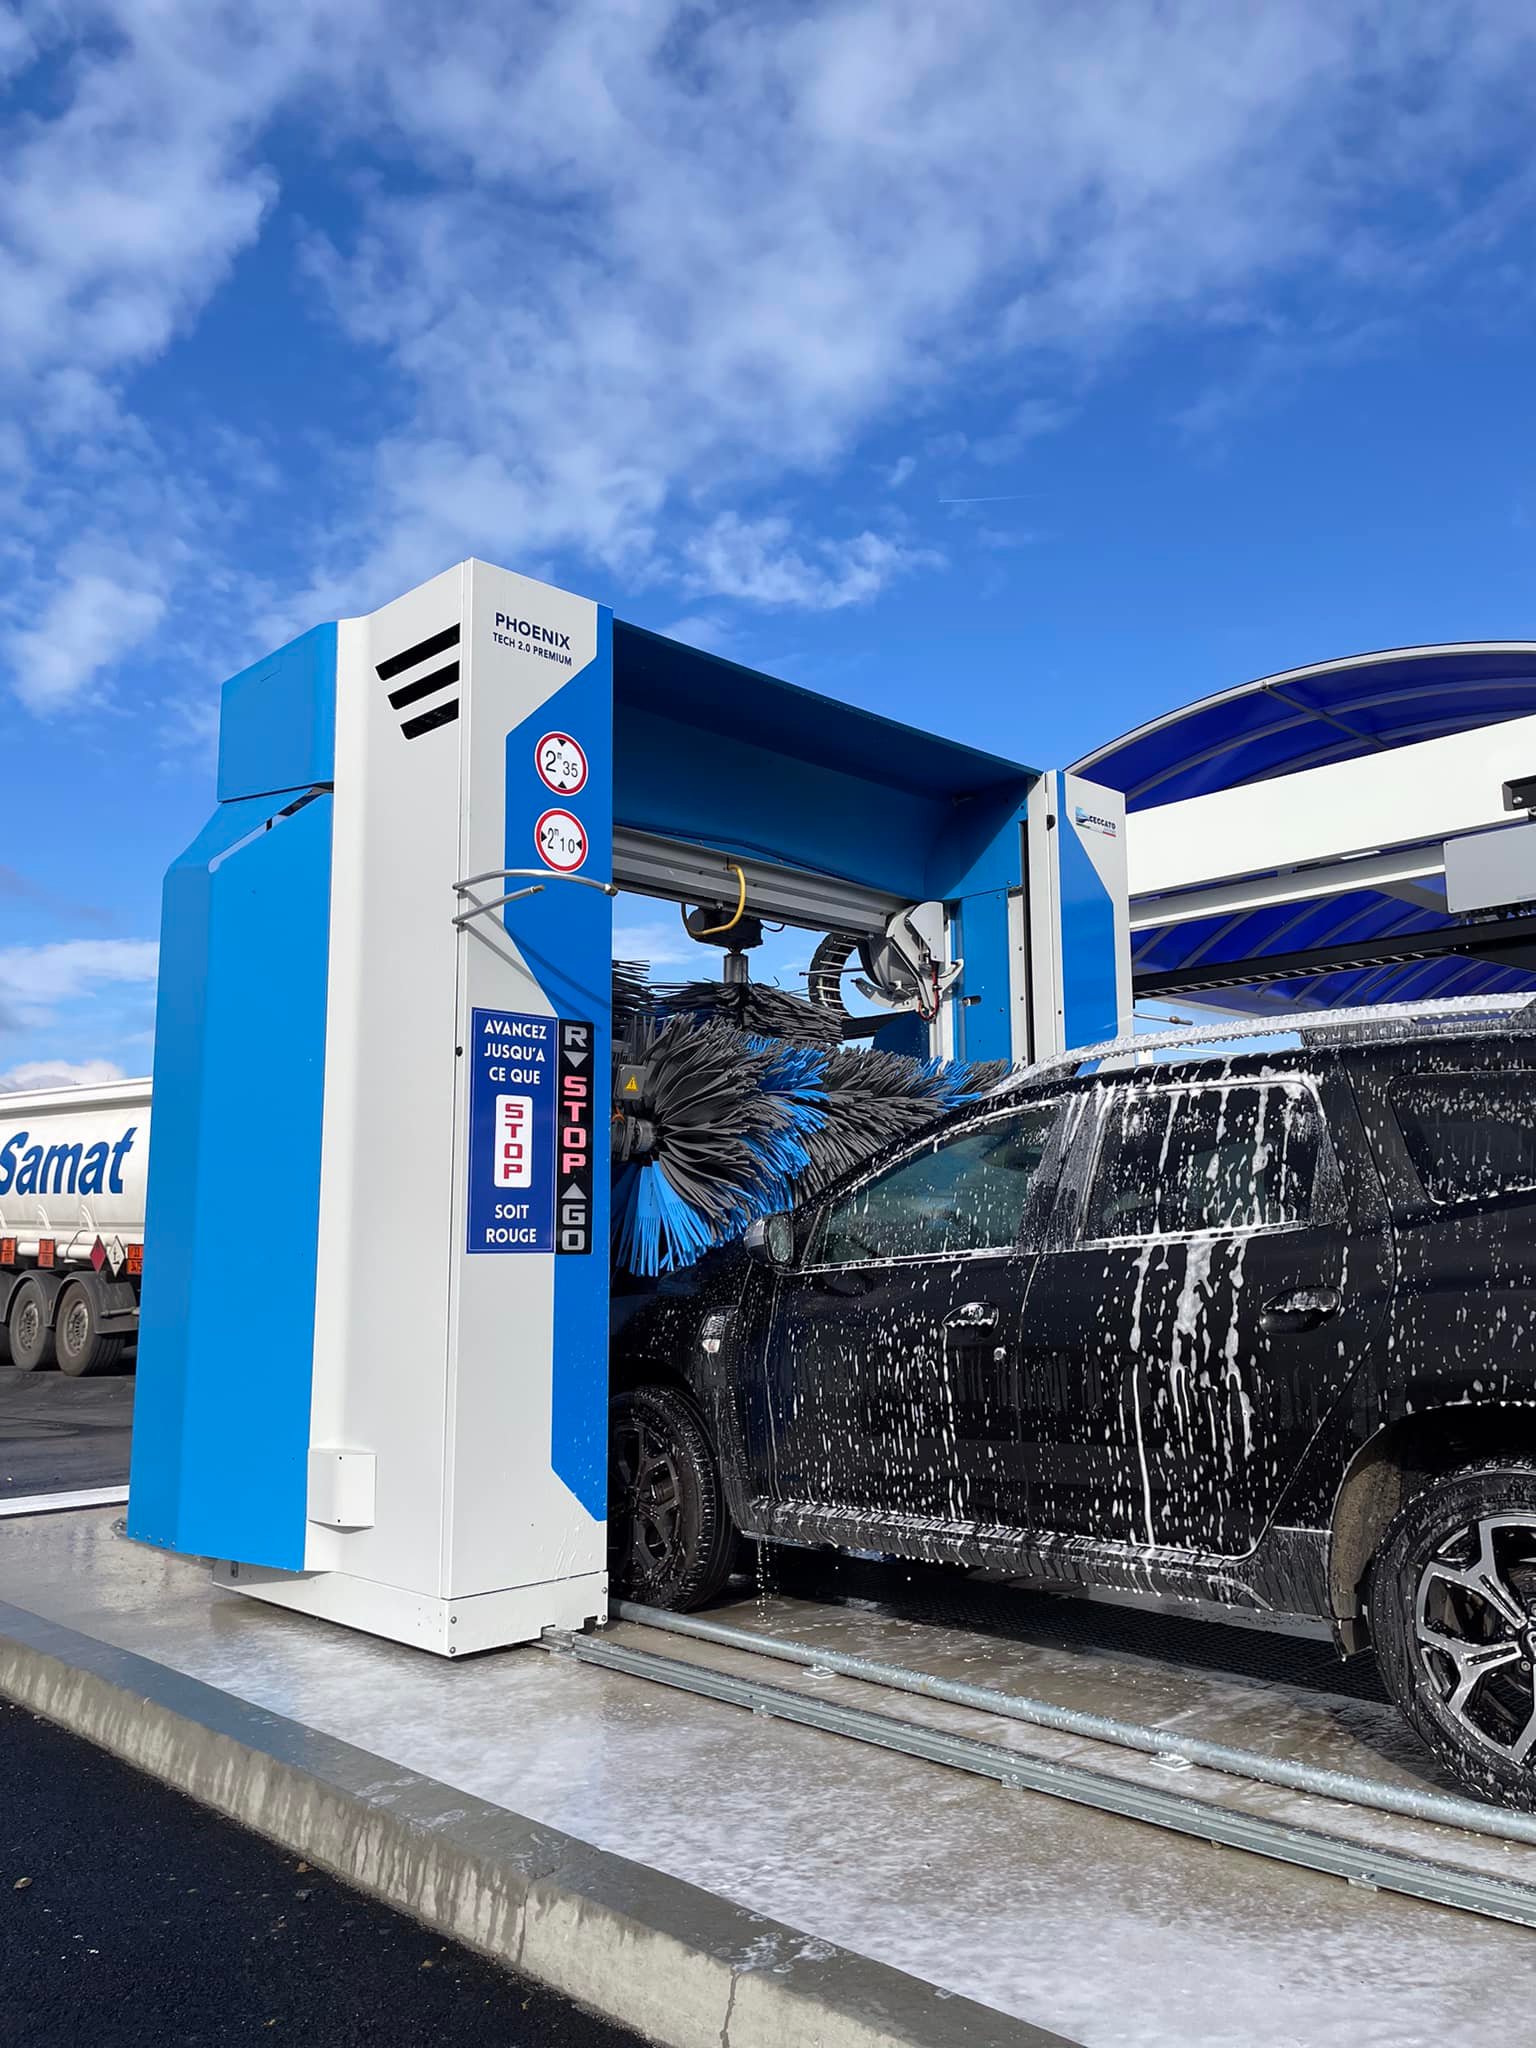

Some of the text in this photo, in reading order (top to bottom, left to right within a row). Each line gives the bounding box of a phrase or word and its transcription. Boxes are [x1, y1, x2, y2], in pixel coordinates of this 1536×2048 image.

[495, 612, 570, 650] PHOENIX
[493, 632, 572, 666] TECH 2.0 PREMIUM
[484, 1020, 547, 1040] AVANCEZ
[484, 1043, 545, 1063] JUSQU'A
[489, 1067, 541, 1085] CE QUE
[503, 1103, 524, 1179] STOP
[562, 1075, 588, 1174] STOP
[0, 1127, 138, 1195] Samat
[495, 1204, 529, 1220] SOIT
[561, 1204, 586, 1251] GO
[486, 1228, 537, 1243] ROUGE
